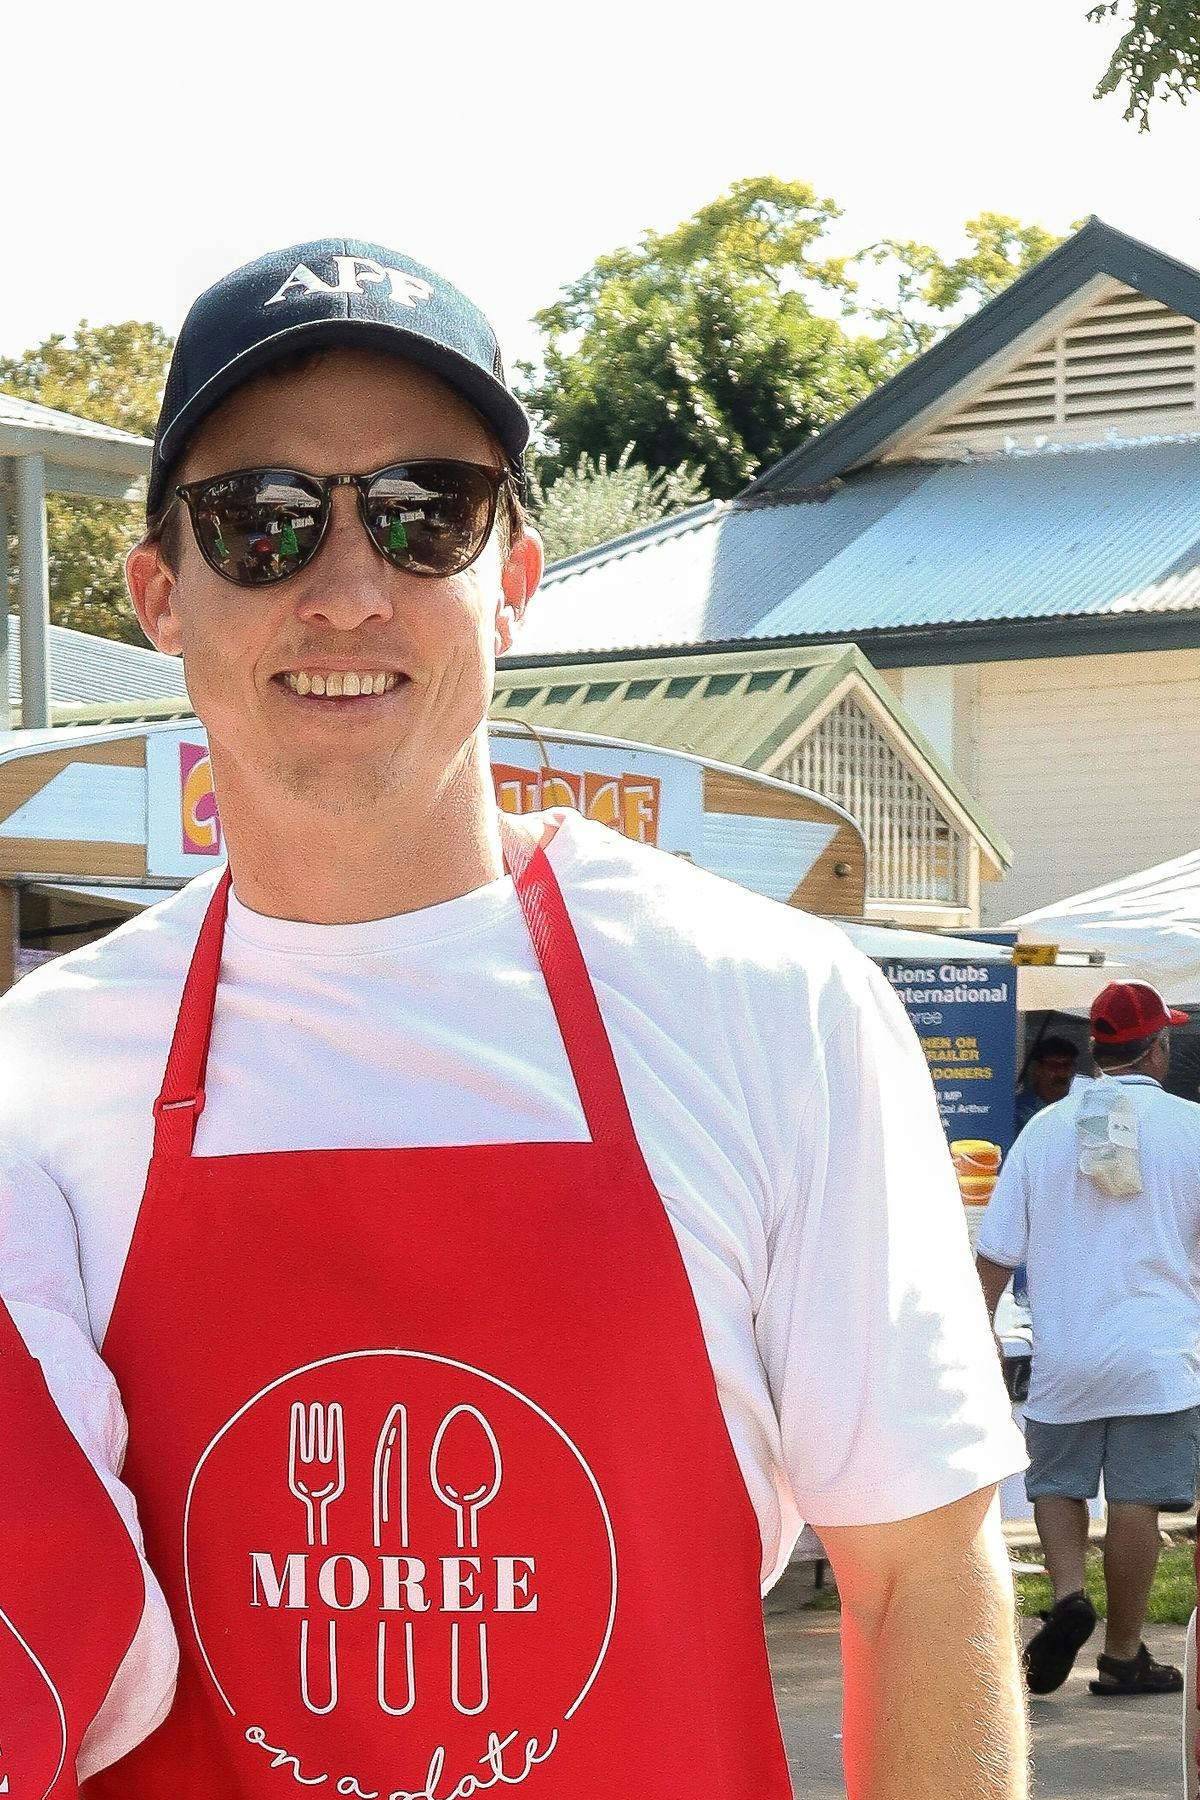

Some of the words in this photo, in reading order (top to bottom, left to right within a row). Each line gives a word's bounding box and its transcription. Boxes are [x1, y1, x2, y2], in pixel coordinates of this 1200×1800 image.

[887, 964, 936, 983] Lions
[939, 964, 990, 982] Clubs
[896, 983, 1008, 1003] nternational
[925, 1049, 980, 1061] RAILER
[248, 1551, 539, 1613] MOREE
[245, 1725, 328, 1785] on
[336, 1773, 379, 1799] a
